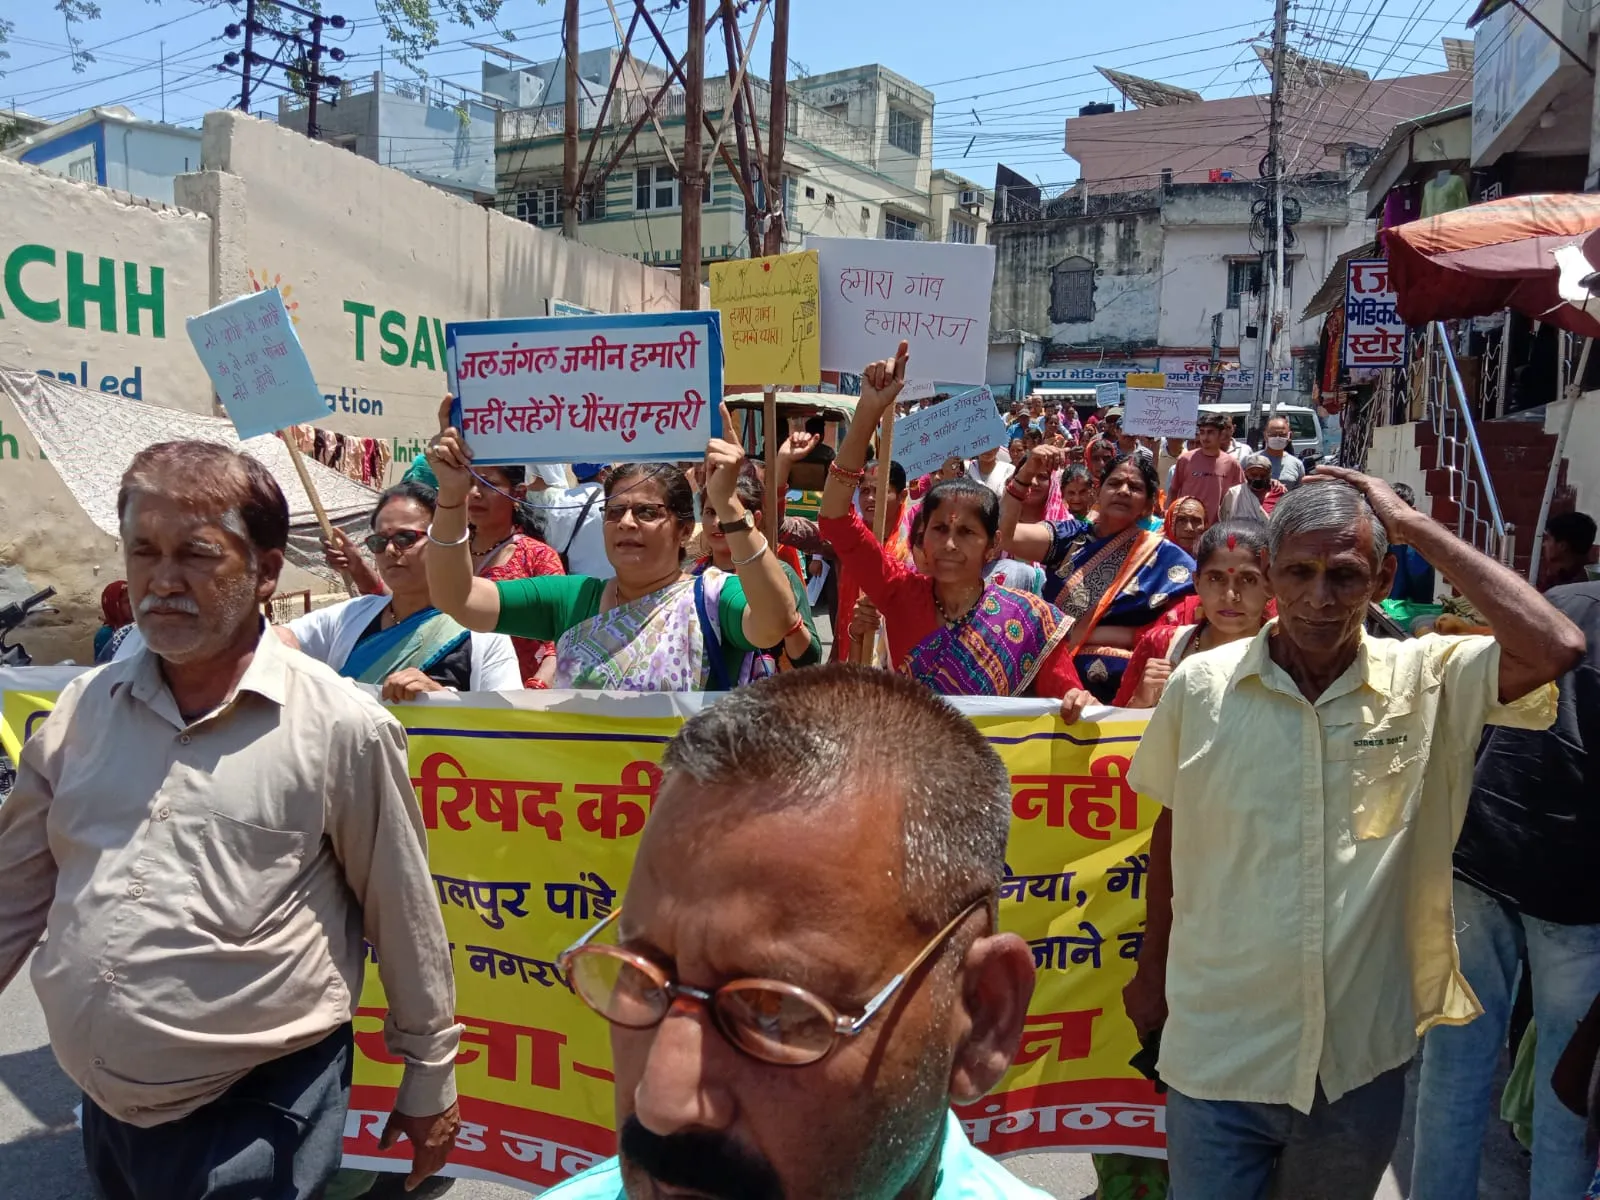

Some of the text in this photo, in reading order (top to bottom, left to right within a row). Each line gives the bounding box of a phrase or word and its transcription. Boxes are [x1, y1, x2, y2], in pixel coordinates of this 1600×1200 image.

[0, 244, 166, 339] CHH
[841, 267, 945, 303] हमारा गांव
[865, 309, 978, 345] हमारा राज
[1347, 326, 1405, 355] स्टोर
[458, 331, 702, 380] जल जंगल जमीन हमारी
[463, 397, 507, 435] नहीं
[620, 389, 706, 443] तुम्हारी
[410, 752, 564, 841] रिषद
